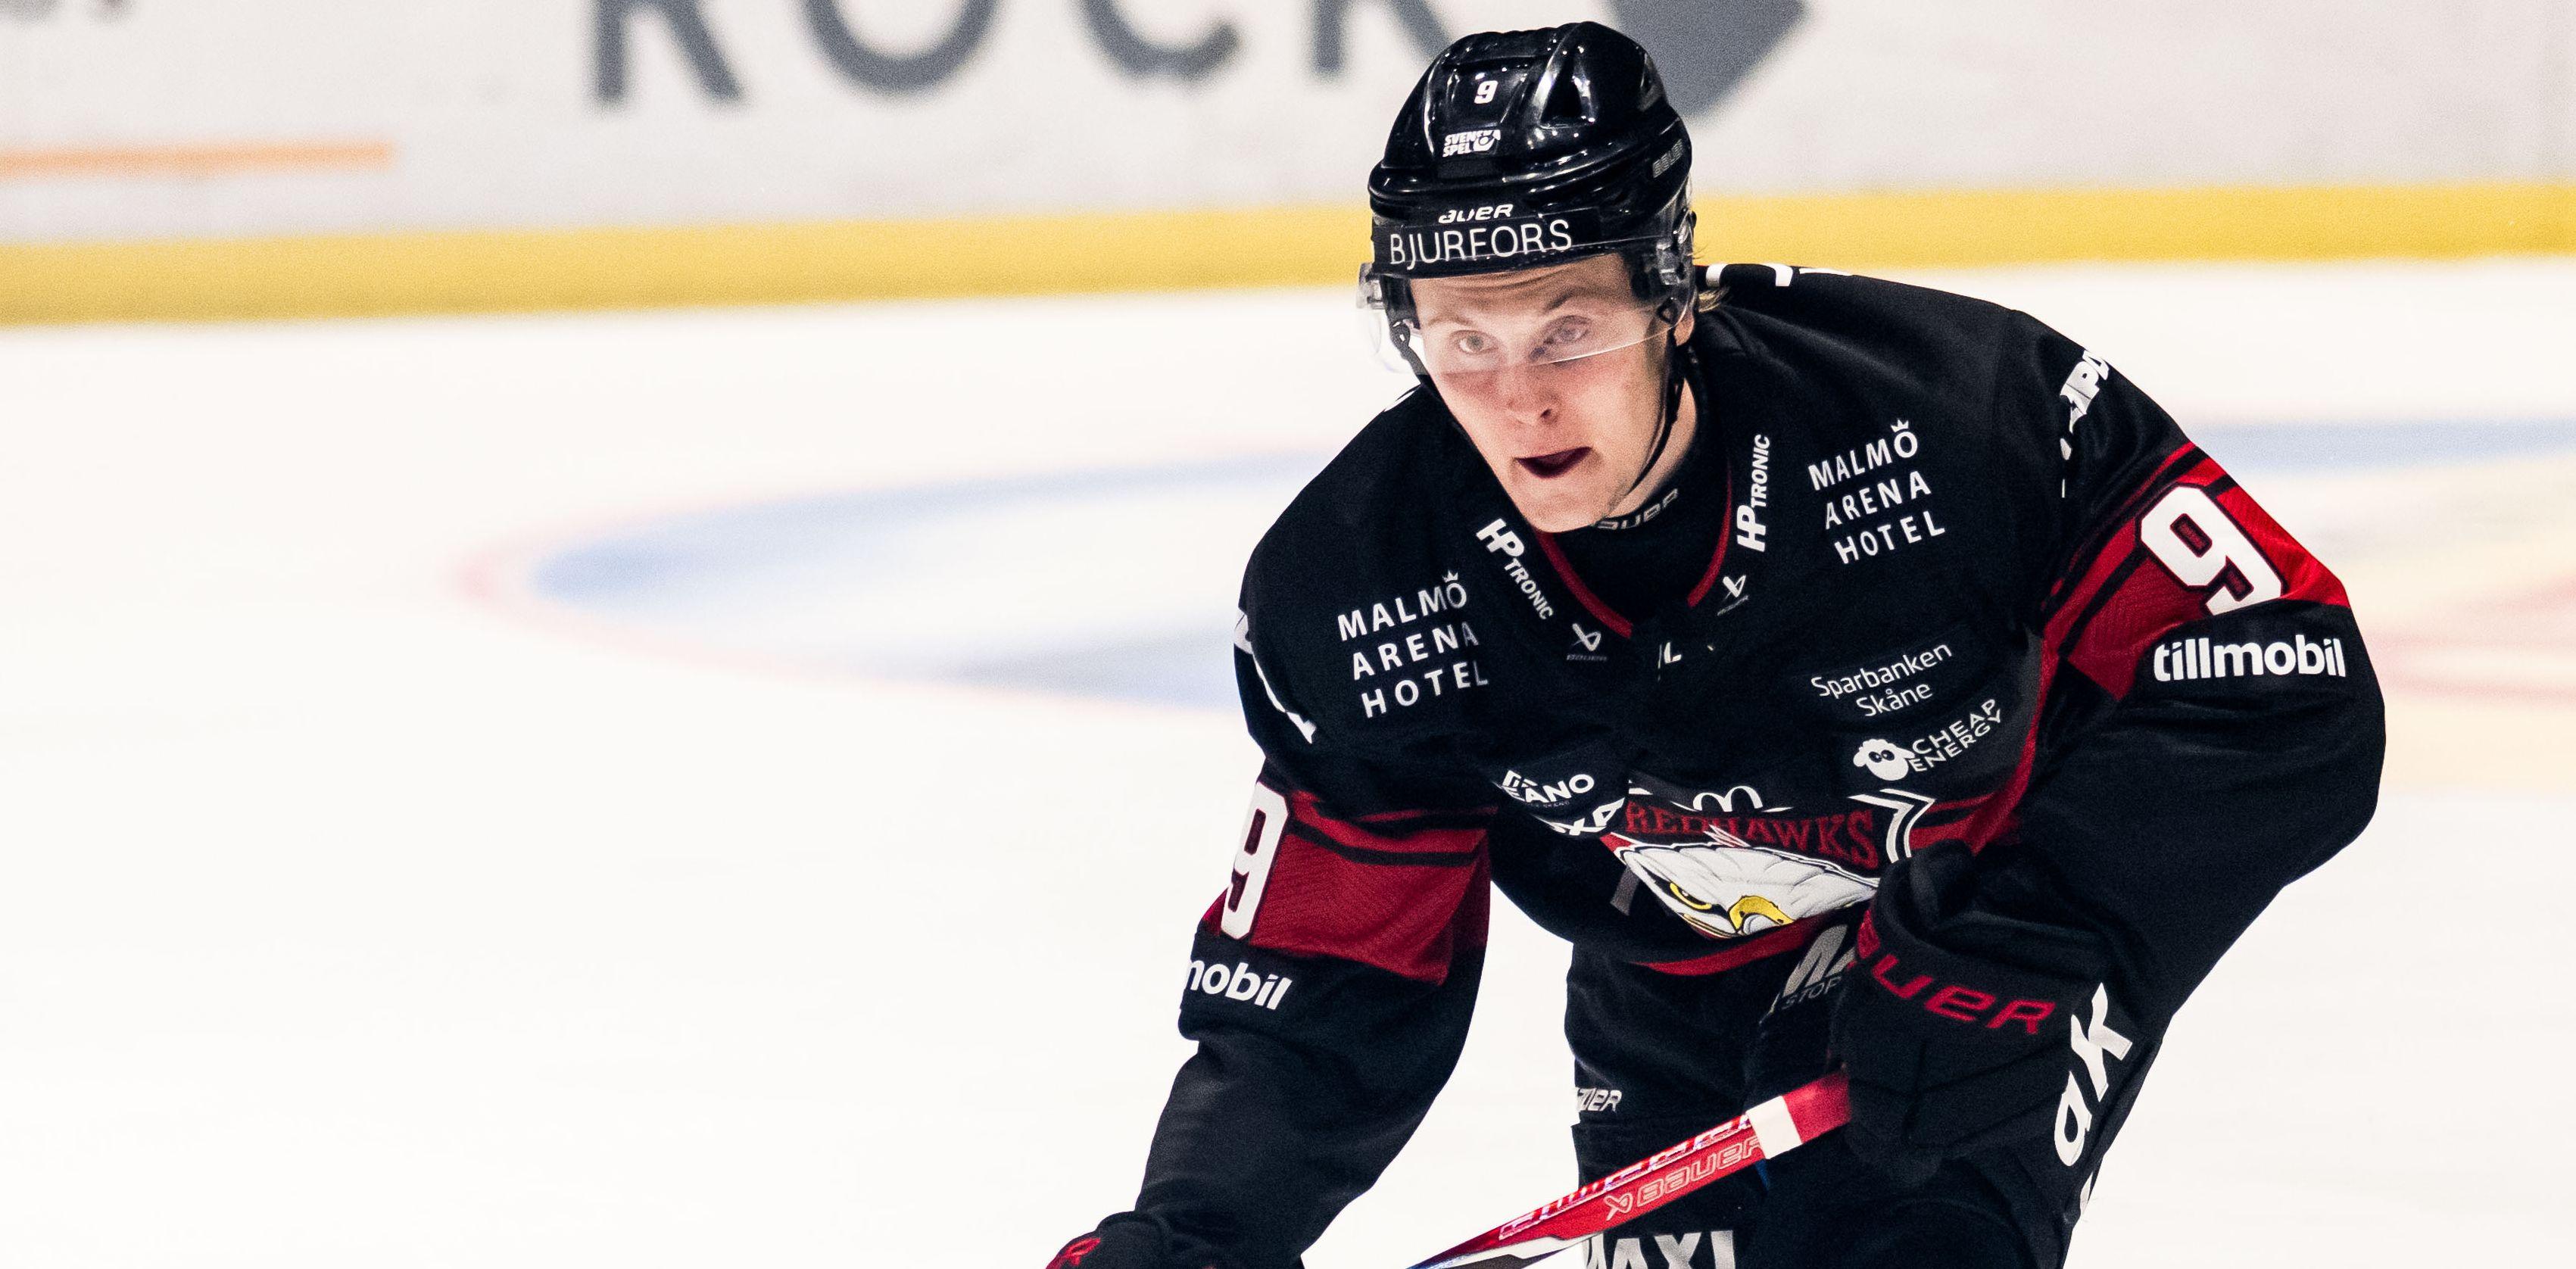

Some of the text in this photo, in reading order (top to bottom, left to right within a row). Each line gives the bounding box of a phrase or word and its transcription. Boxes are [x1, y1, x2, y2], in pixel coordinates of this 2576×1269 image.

[1474, 80, 1498, 104] 9
[1390, 220, 1572, 270] BJURFORS
[1826, 470, 1932, 530] ARENA
[1834, 510, 1945, 564] HOTEL
[2141, 485, 2283, 616] 9
[1353, 621, 1479, 681] ARENA
[1810, 644, 1953, 699] Sparbanken
[2154, 634, 2346, 681] tillmobil
[1361, 661, 1488, 718] HOTEL
[1856, 684, 1932, 716] Skåne
[1908, 709, 2001, 772] ENERGY
[1912, 699, 1996, 754] CHEAP
[1221, 781, 1289, 940] 9
[1626, 800, 1879, 868] REDHAWKS
